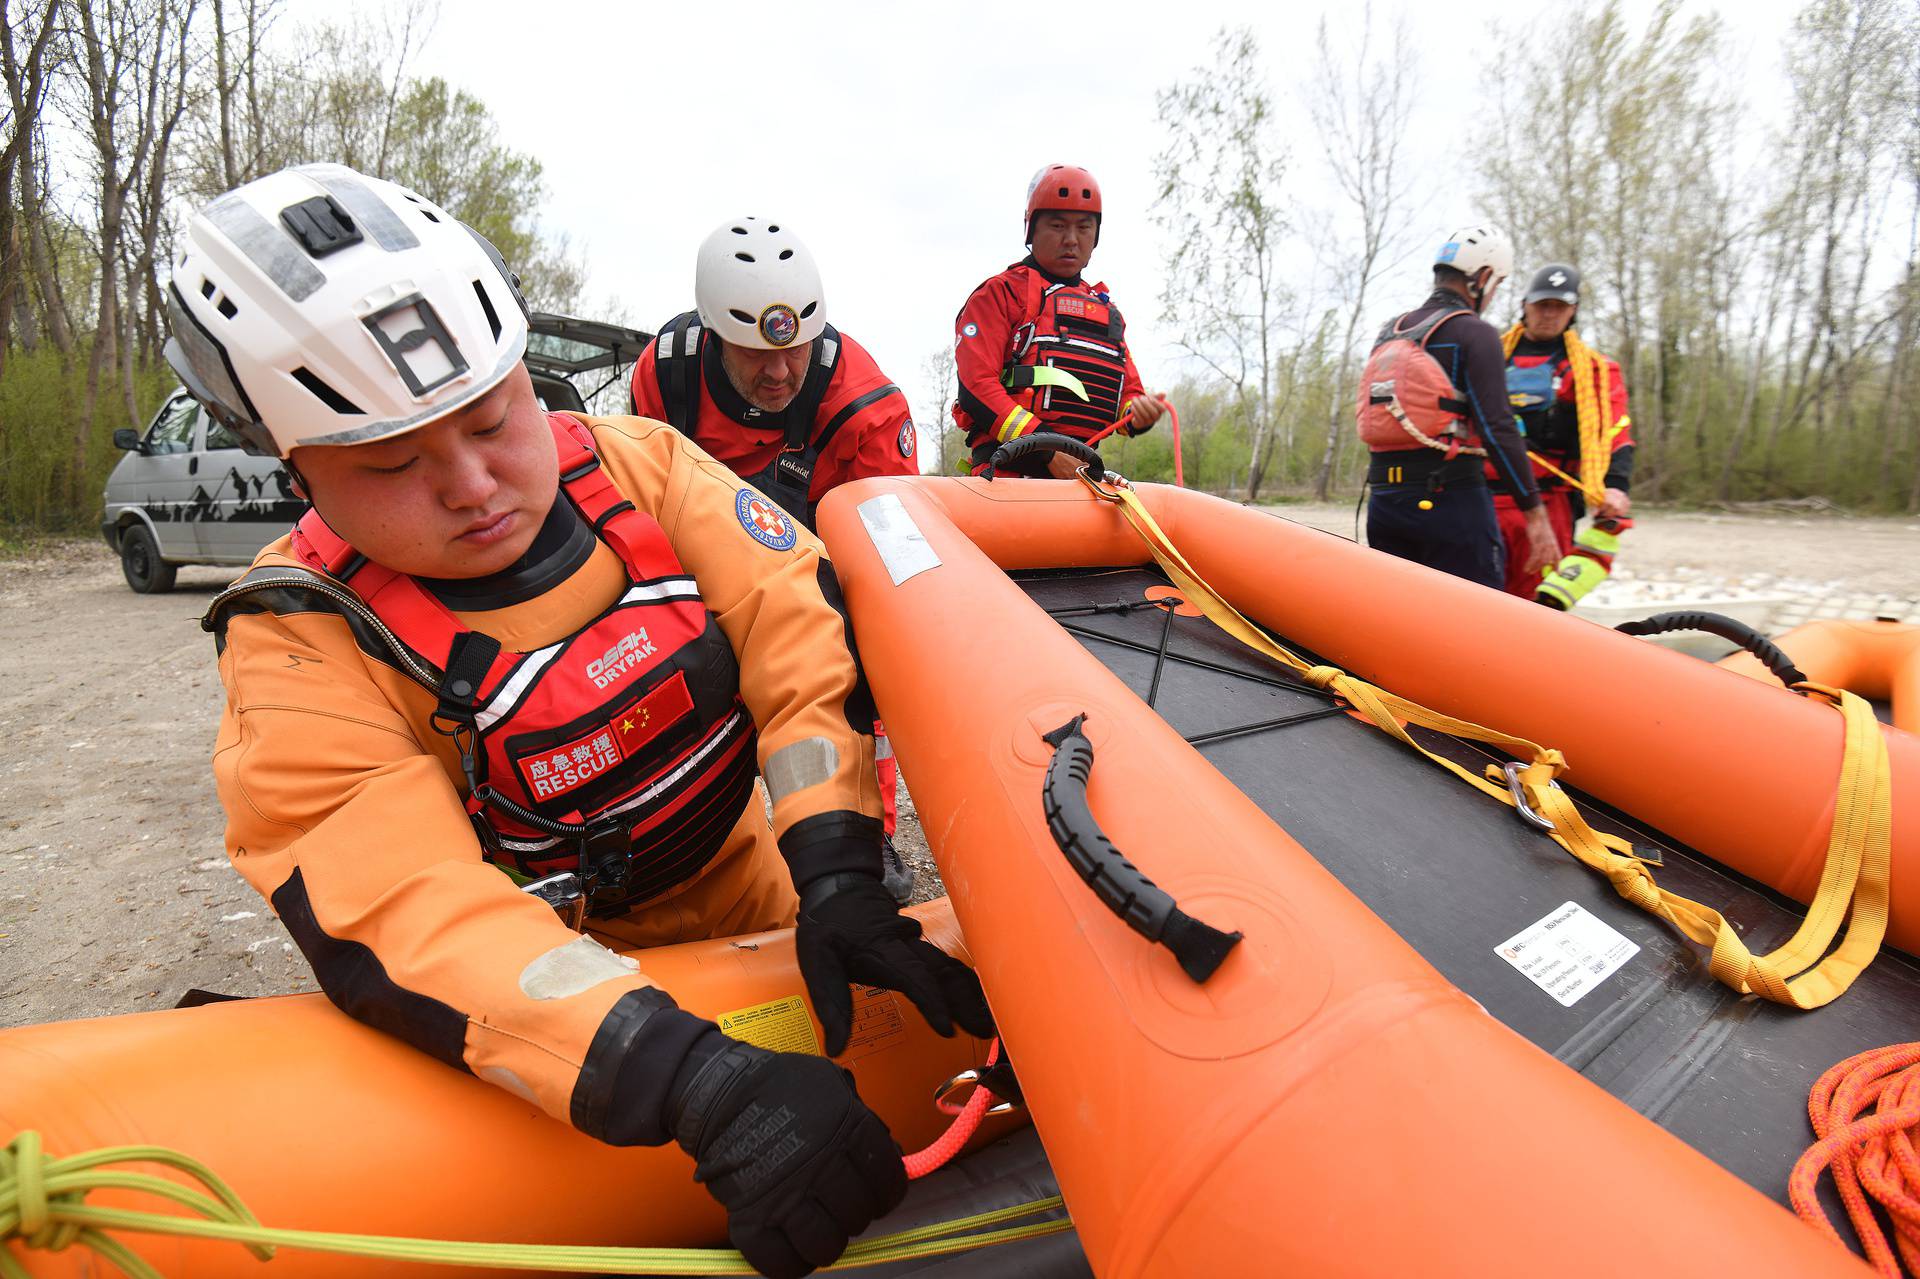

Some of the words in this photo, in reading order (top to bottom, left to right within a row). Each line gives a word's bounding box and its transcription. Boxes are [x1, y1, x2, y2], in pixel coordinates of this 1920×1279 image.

[586, 627, 649, 679] OSAH
[593, 641, 657, 689] DRYPAK
[530, 732, 613, 780] 应急救援
[534, 749, 619, 797] RESCUE
[1511, 942, 1527, 953] MFC
